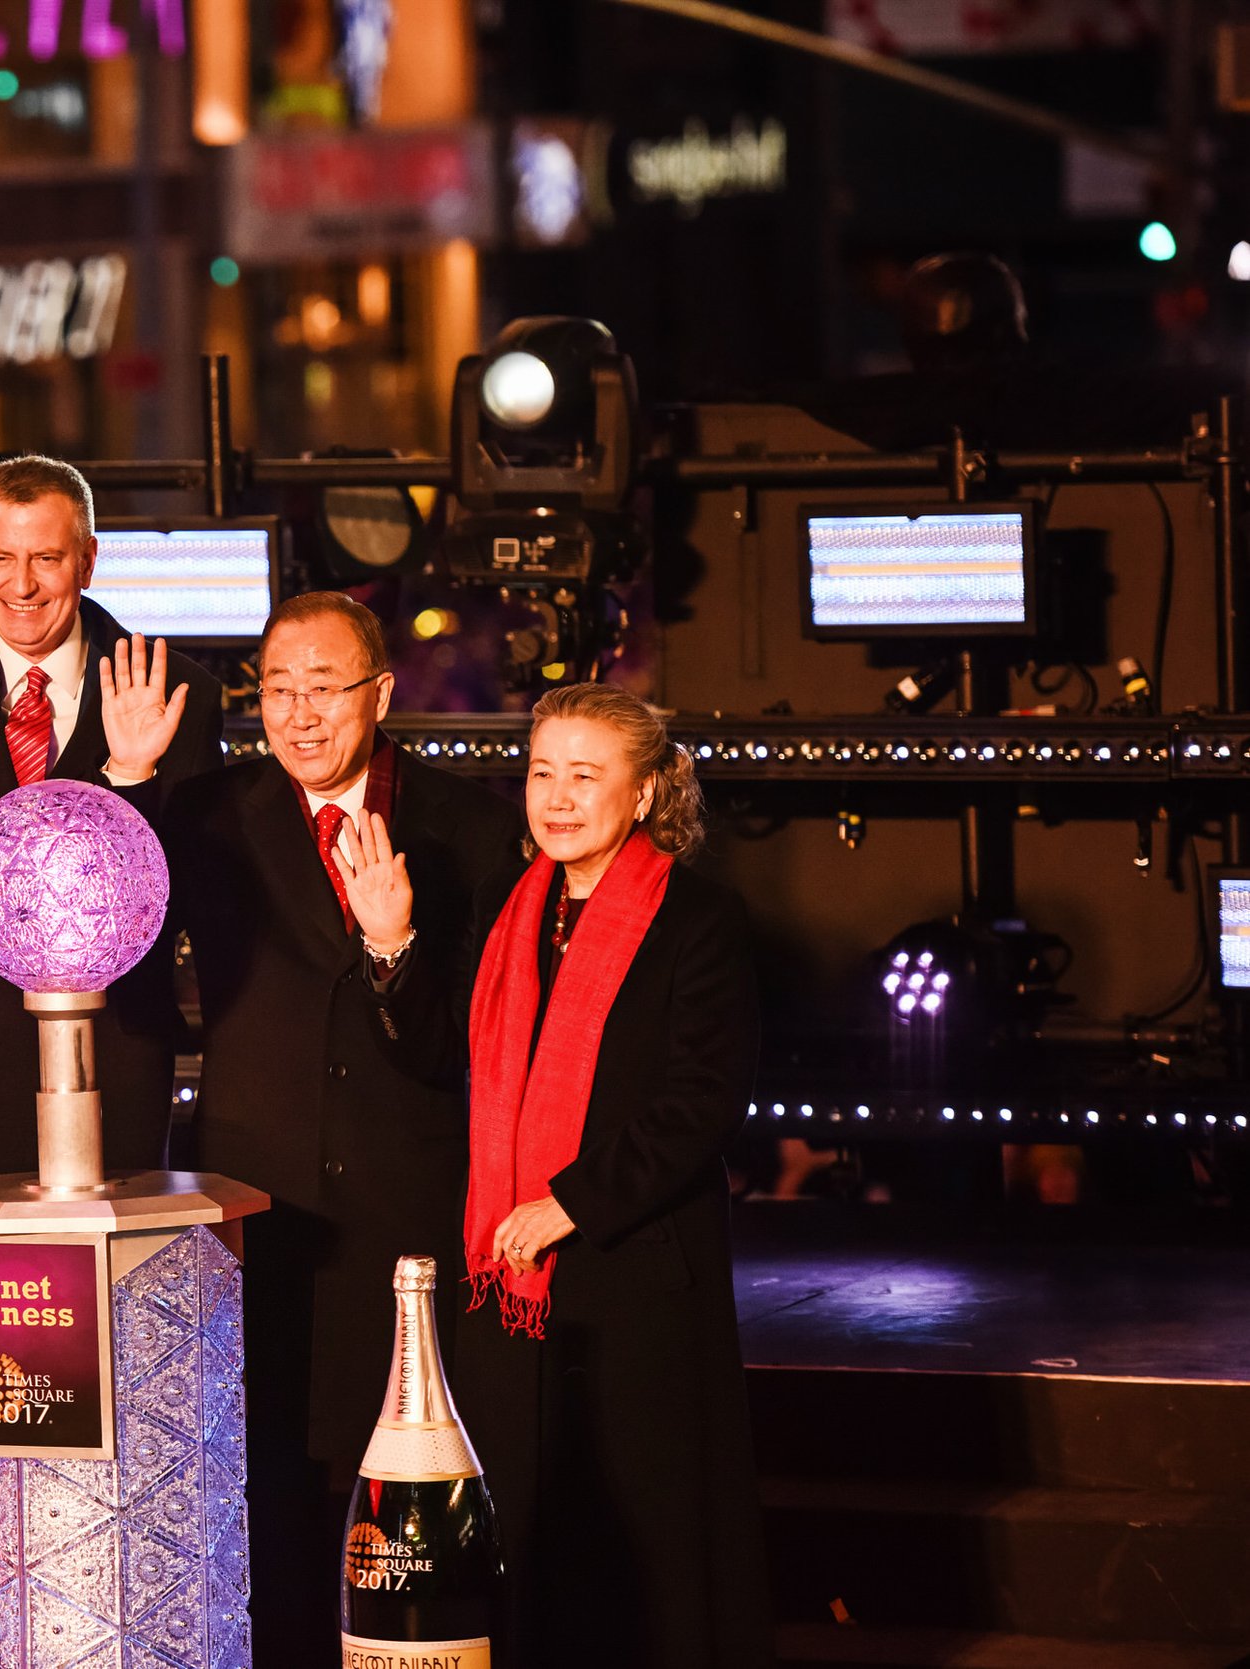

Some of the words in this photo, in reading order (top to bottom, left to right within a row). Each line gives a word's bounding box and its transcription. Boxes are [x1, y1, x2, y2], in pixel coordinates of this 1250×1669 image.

[2, 1374, 51, 1388] TIMES
[397, 1355, 415, 1414] BAREFOOT
[13, 1388, 75, 1404] SQUARE
[370, 1543, 413, 1557] TIMES
[376, 1557, 433, 1573] SQUARE
